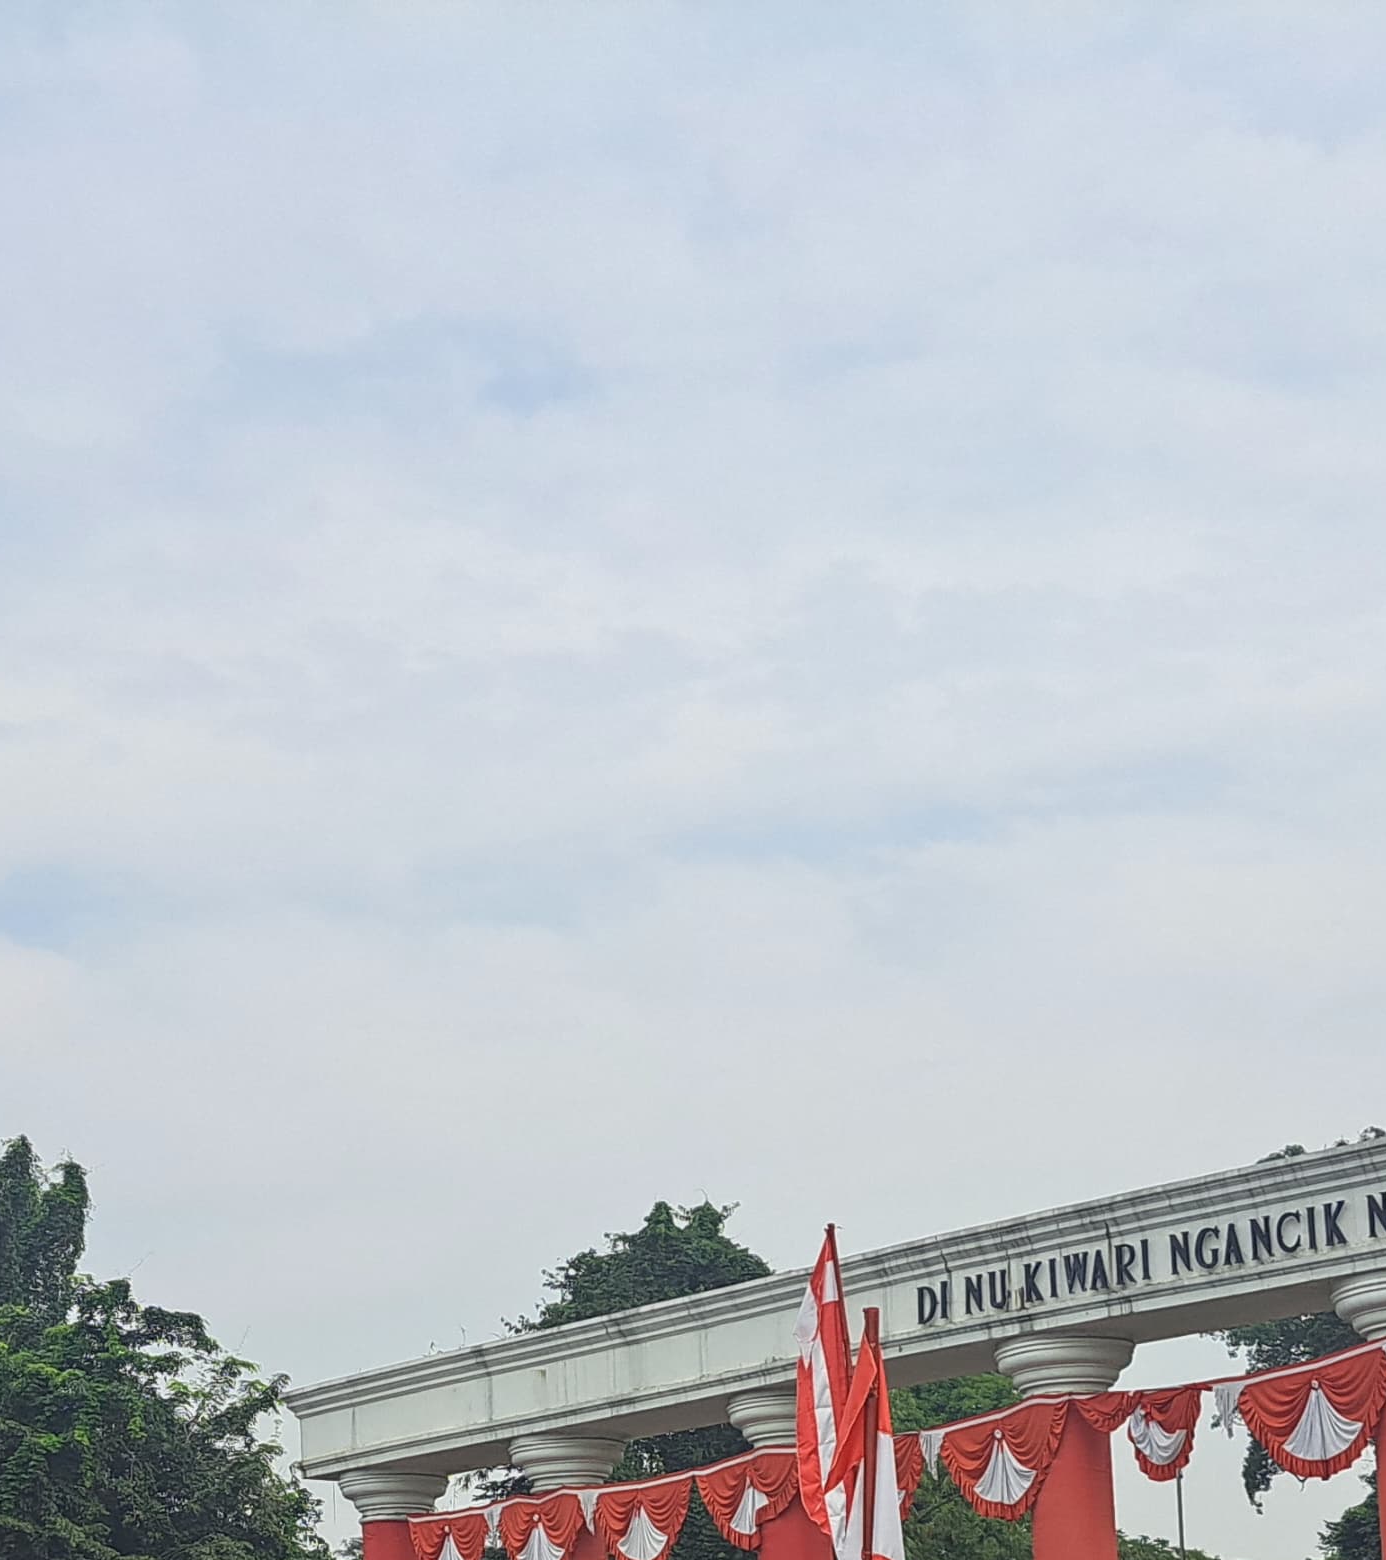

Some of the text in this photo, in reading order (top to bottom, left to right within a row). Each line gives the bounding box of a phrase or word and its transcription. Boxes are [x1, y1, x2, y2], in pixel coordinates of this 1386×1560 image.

[916, 1280, 949, 1325] DI
[964, 1269, 1008, 1315] NU
[1023, 1238, 1152, 1304] KIWARI
[1169, 1199, 1348, 1275] NGANCIK
